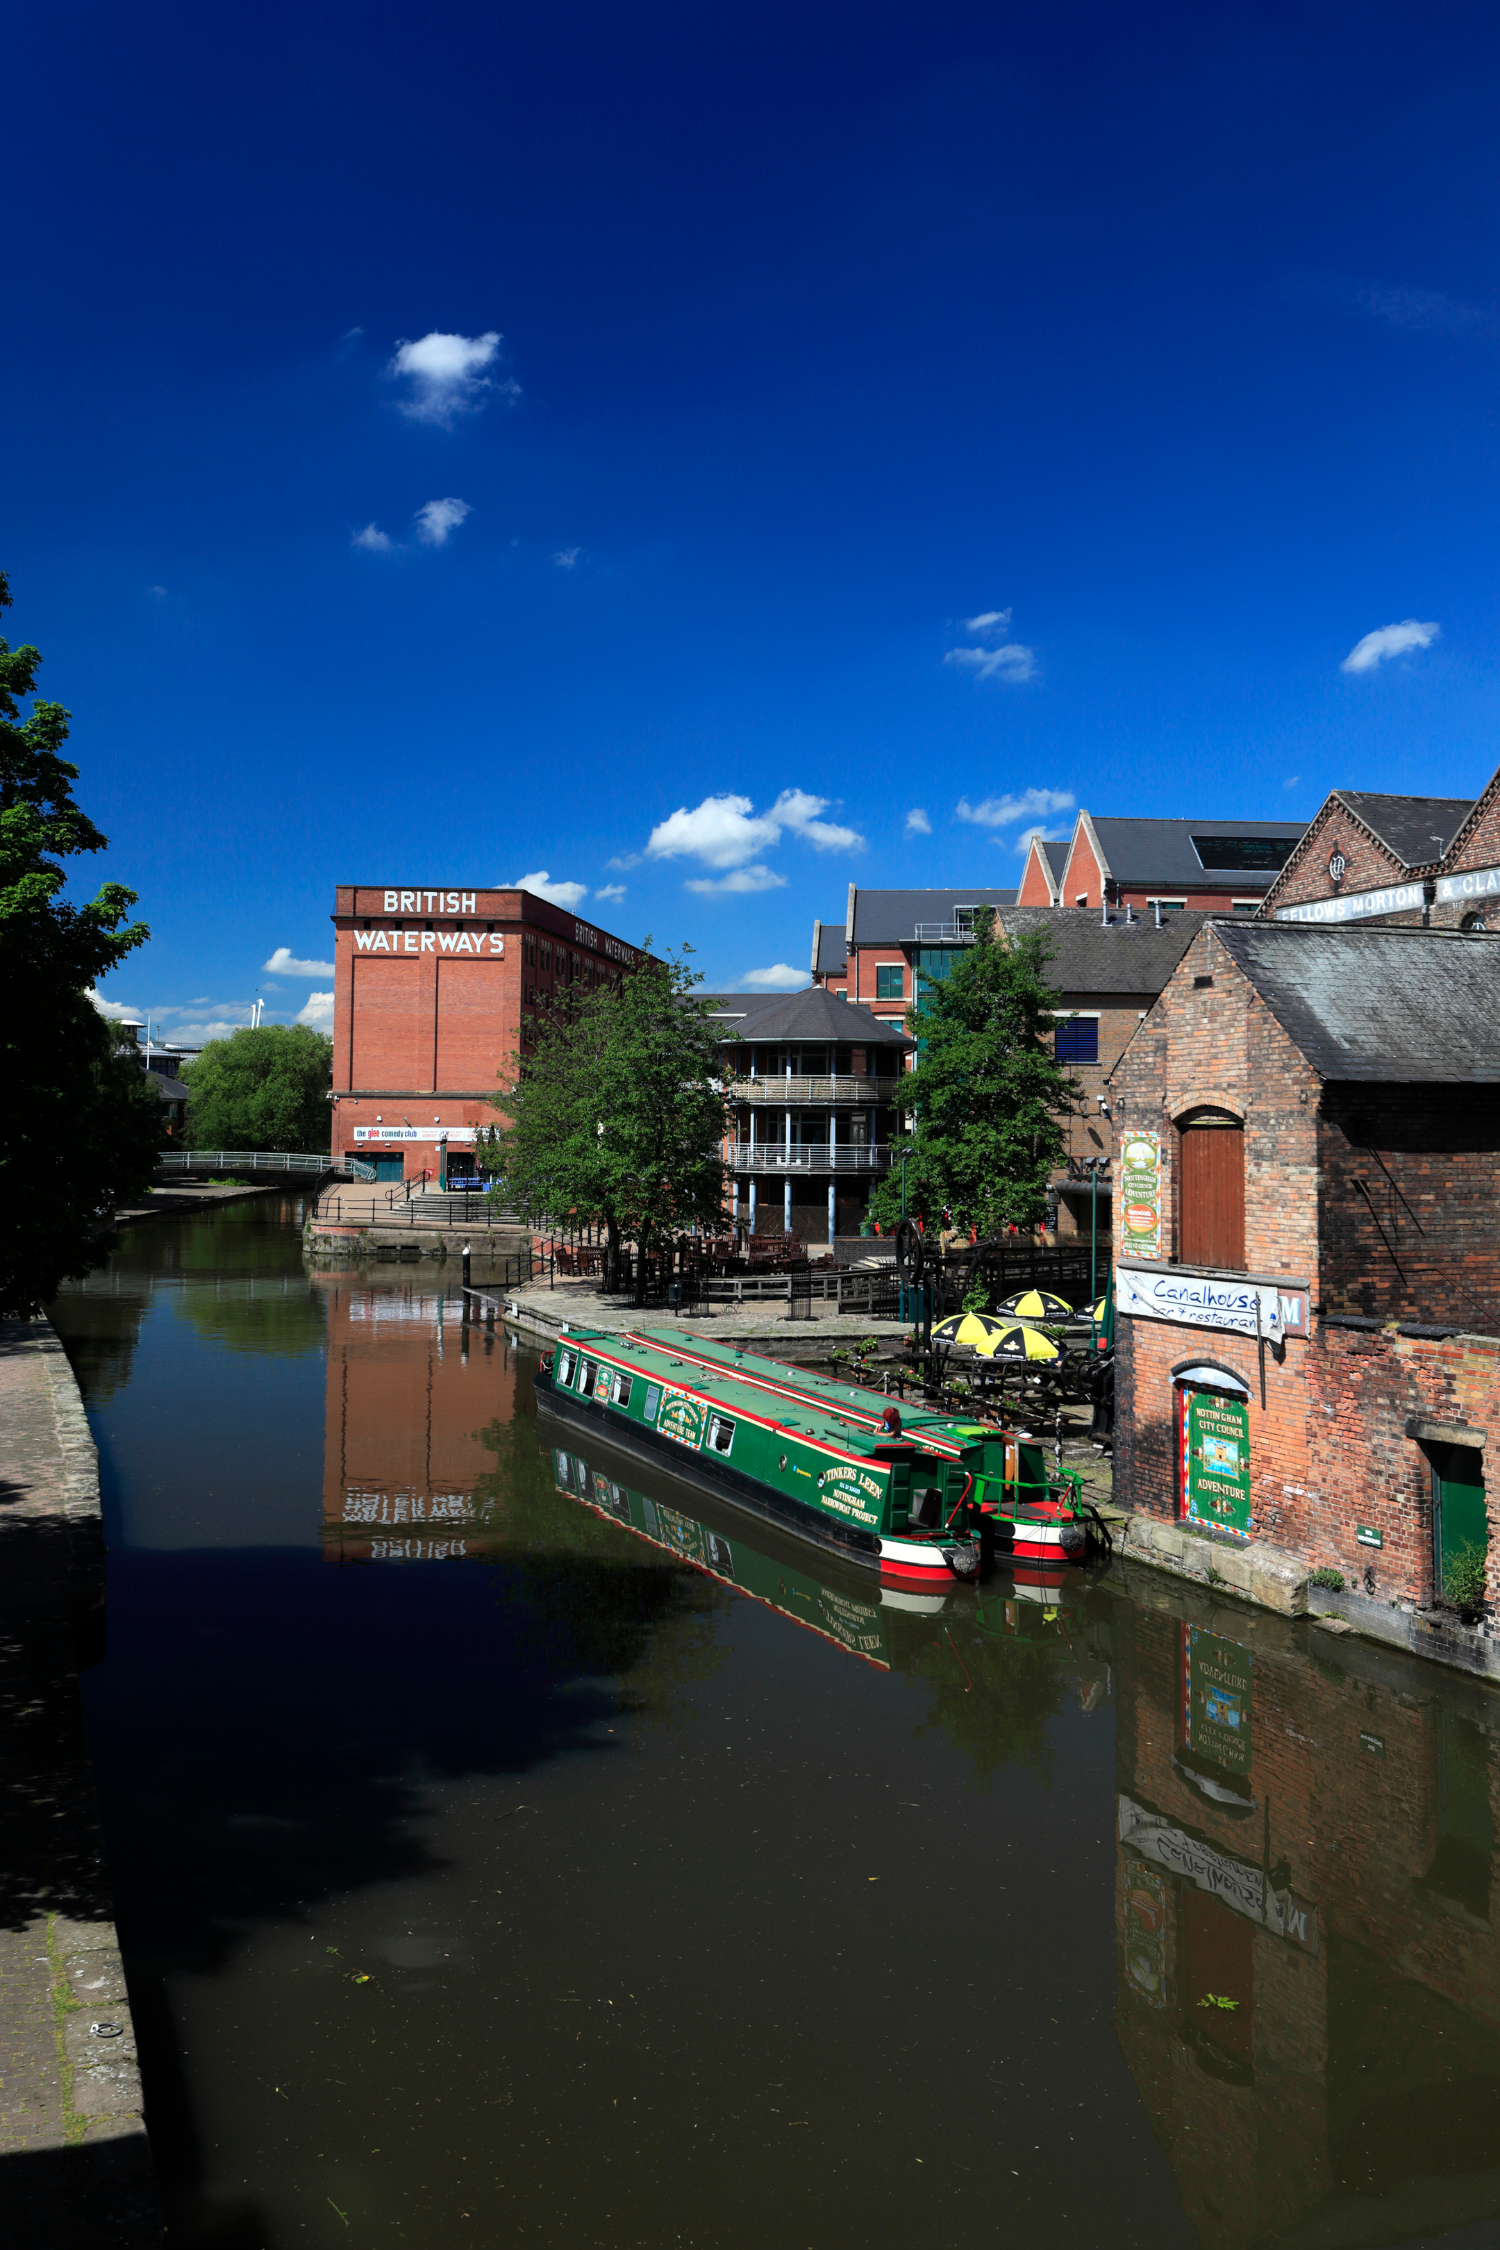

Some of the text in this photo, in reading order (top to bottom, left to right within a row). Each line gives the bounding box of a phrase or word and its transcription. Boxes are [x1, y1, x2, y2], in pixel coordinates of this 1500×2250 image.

[384, 891, 476, 913] BRITISH
[1281, 872, 1500, 921] FELLOWS MORTON & CLA
[354, 930, 503, 953] WATERWAYS
[575, 922, 634, 961] BRITISH WATERWAYS
[356, 1128, 418, 1139] the glee comedy club
[1124, 1175, 1156, 1183] NOTTINGHAM
[1124, 1189, 1156, 1198] ADVENTURE
[1153, 1280, 1262, 1311] Canalhouse
[1196, 1408, 1242, 1425] NOTTINGHAM
[663, 1419, 696, 1441] ADVENTURE TEAM
[1199, 1420, 1244, 1439] CITY COUNCIL
[826, 1466, 857, 1483] TINKERS
[858, 1472, 883, 1500] LEEN
[1197, 1479, 1245, 1501] ADVENTURE
[821, 1494, 878, 1525] NARROWBOAT PROJECT
[833, 1488, 866, 1510] NOTTINGHAM
